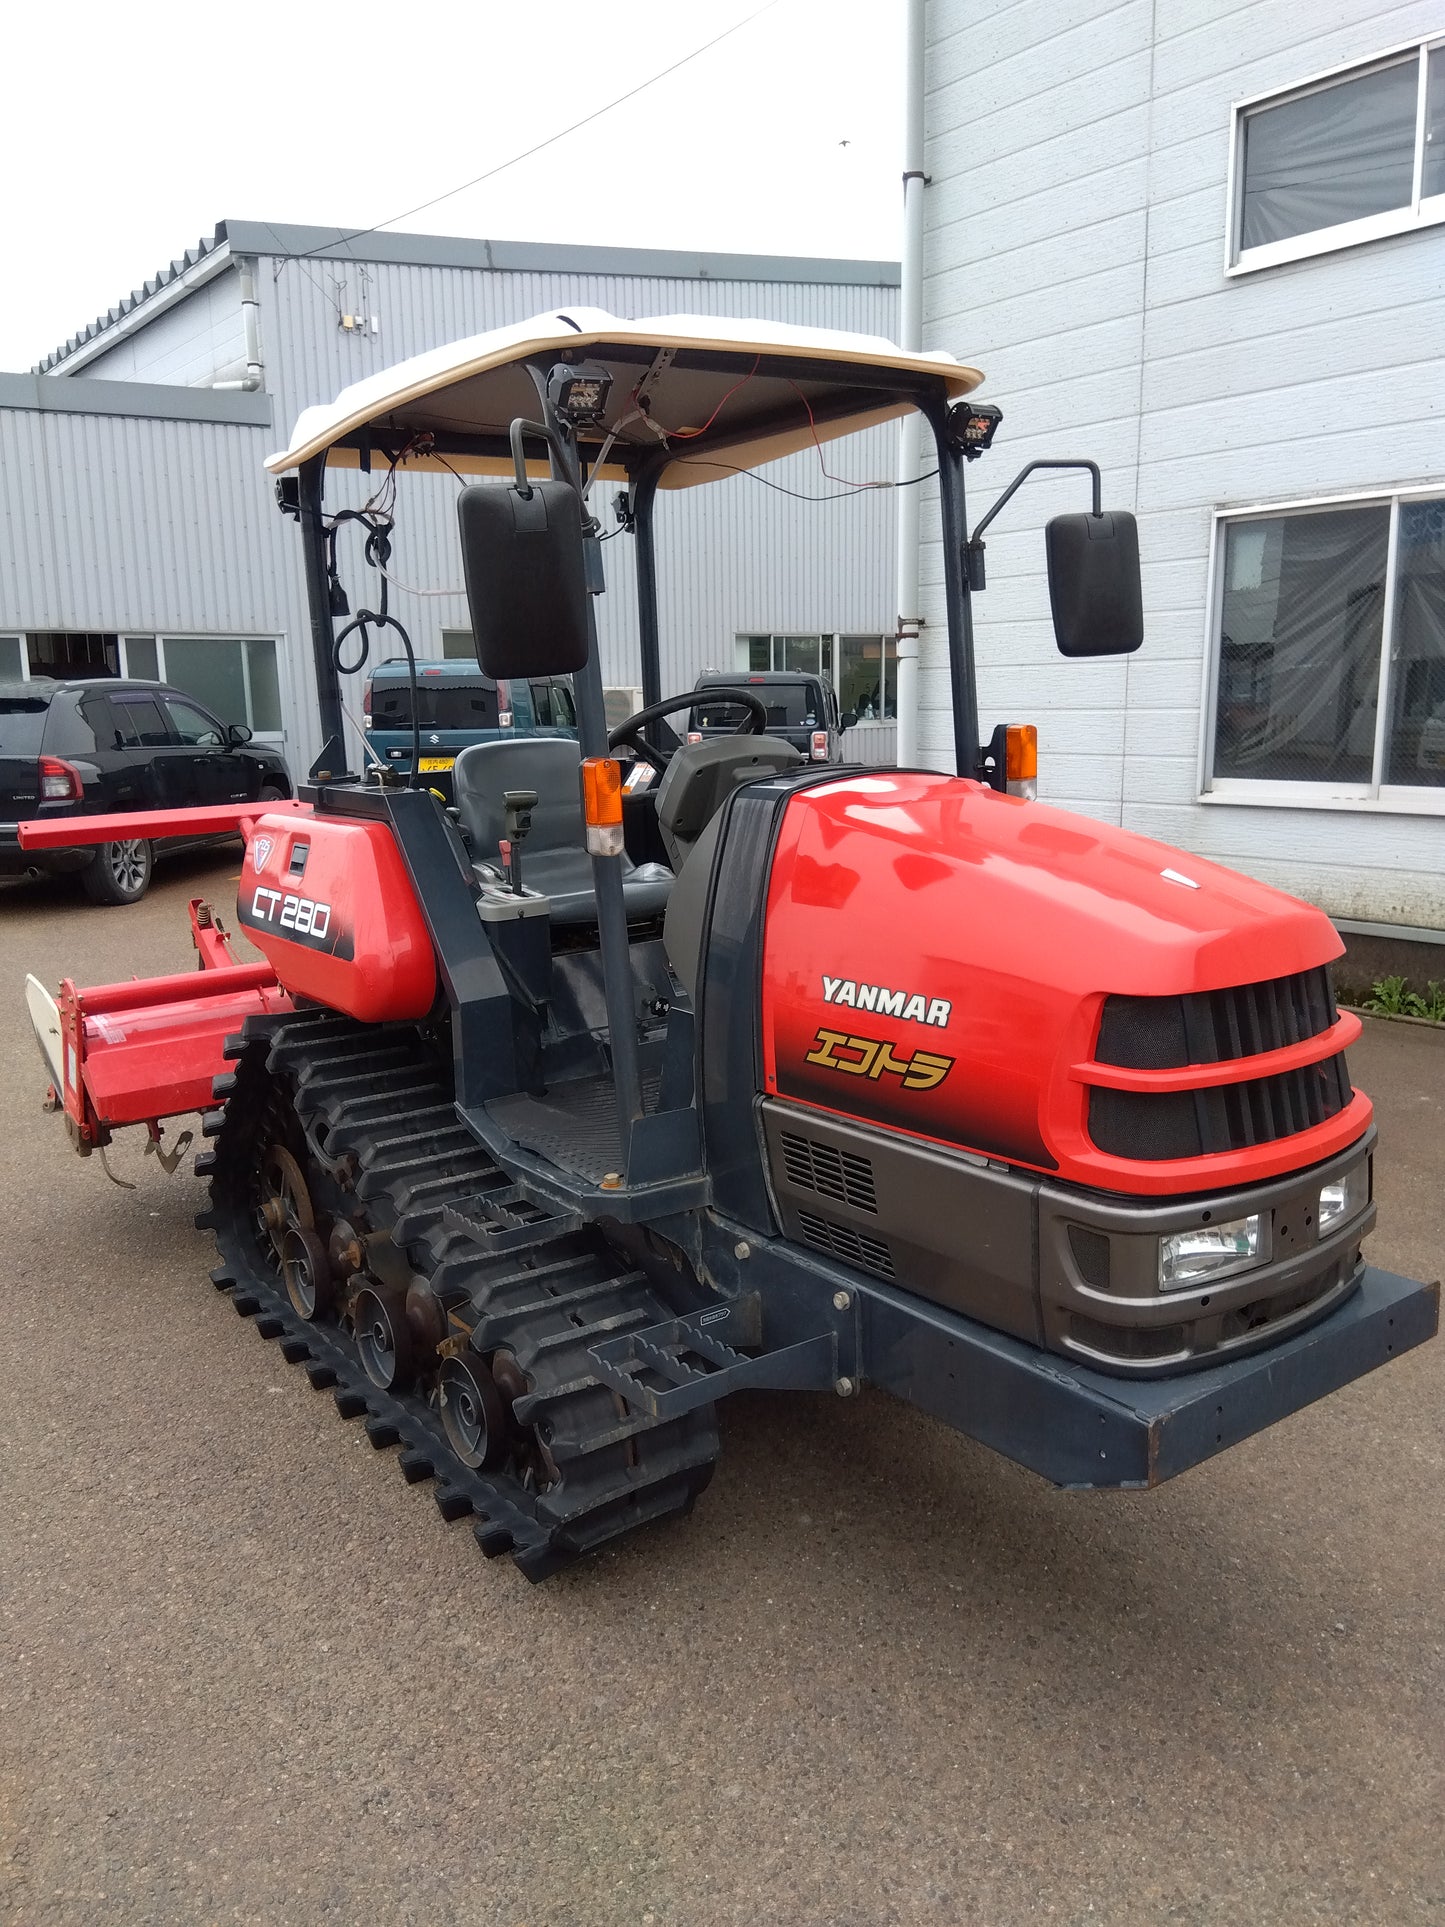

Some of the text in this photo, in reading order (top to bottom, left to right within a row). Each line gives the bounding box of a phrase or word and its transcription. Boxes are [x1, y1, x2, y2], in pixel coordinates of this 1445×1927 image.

[822, 976, 952, 1028] YANMAR
[804, 1027, 957, 1091] エコトラ
